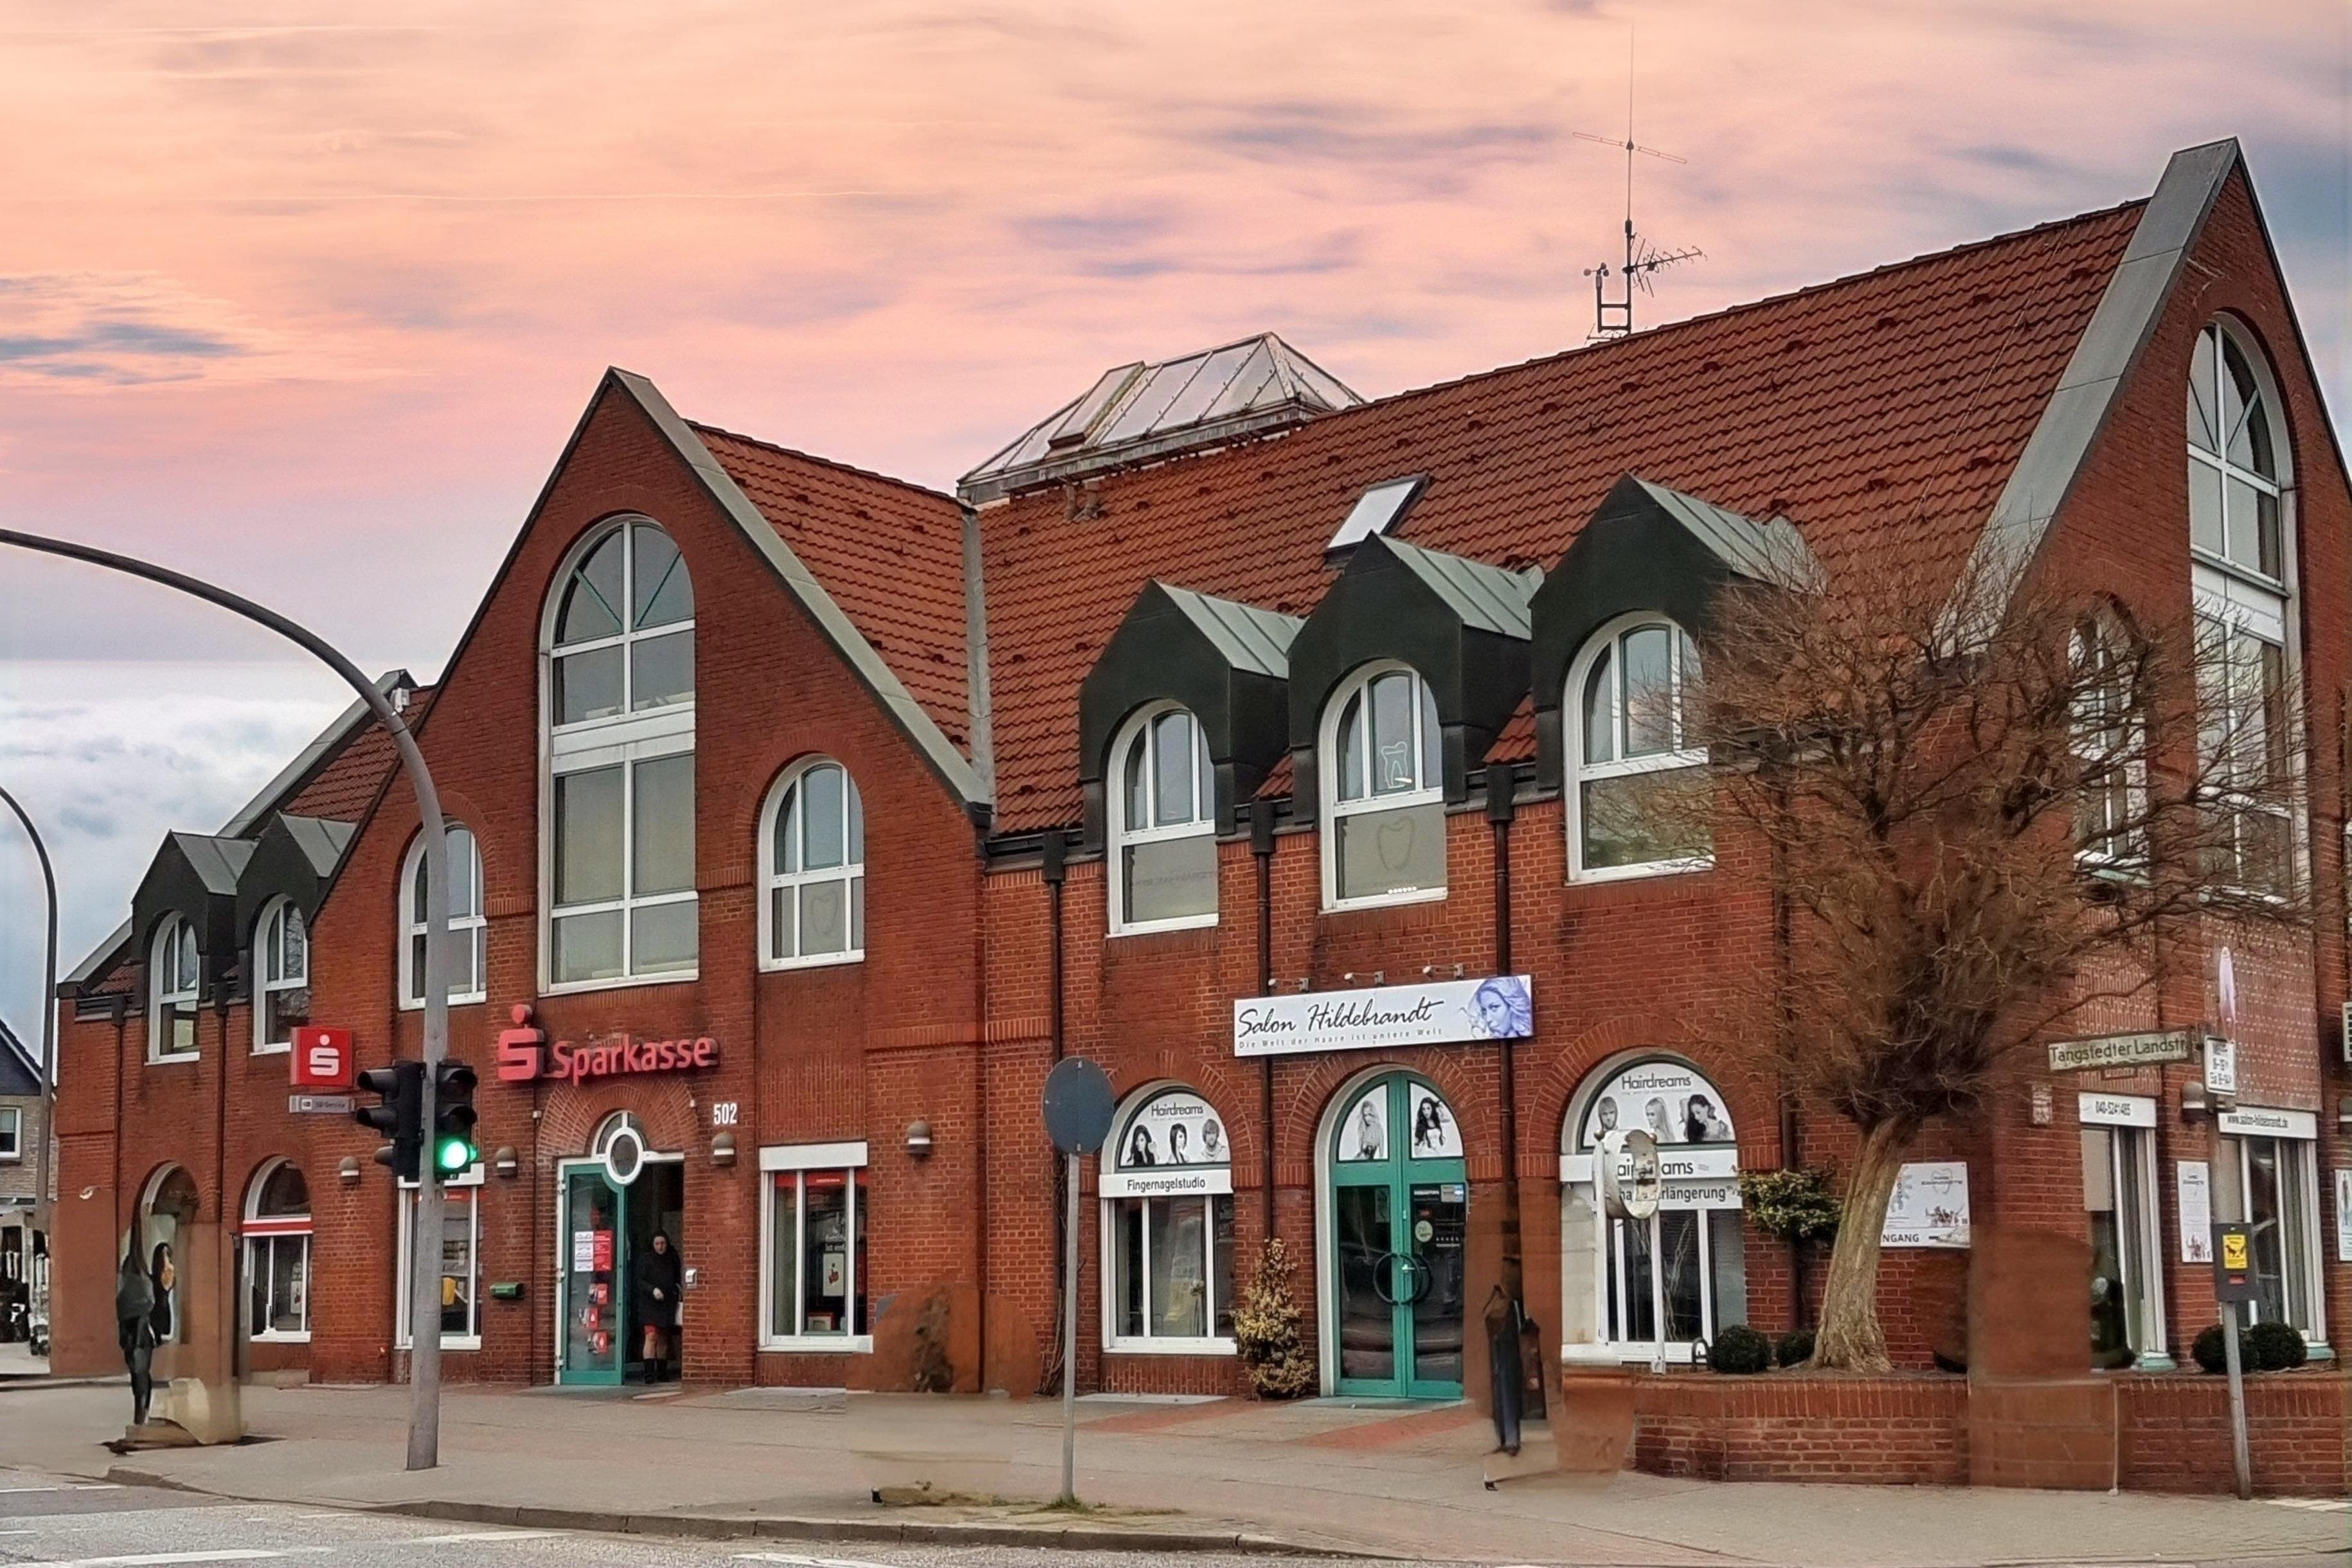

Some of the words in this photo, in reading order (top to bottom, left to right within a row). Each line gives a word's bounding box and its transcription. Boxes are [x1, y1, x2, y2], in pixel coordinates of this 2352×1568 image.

[1238, 1008, 1297, 1038] Salon
[1307, 996, 1444, 1031] Hildebrandt
[1262, 1038, 1284, 1047] Welt
[1373, 1031, 1409, 1040] unsere
[1417, 1028, 1441, 1036] Welt
[552, 1033, 714, 1086] Sparkasse
[2049, 1042, 2132, 1064] Tangstedter
[1622, 1073, 1691, 1089] Hairdreams
[714, 1103, 738, 1125] 502
[1151, 1102, 1204, 1117] Hairdreams
[1127, 1176, 1206, 1193] Fingernagelstudio
[1883, 1233, 1919, 1243] NGANG
